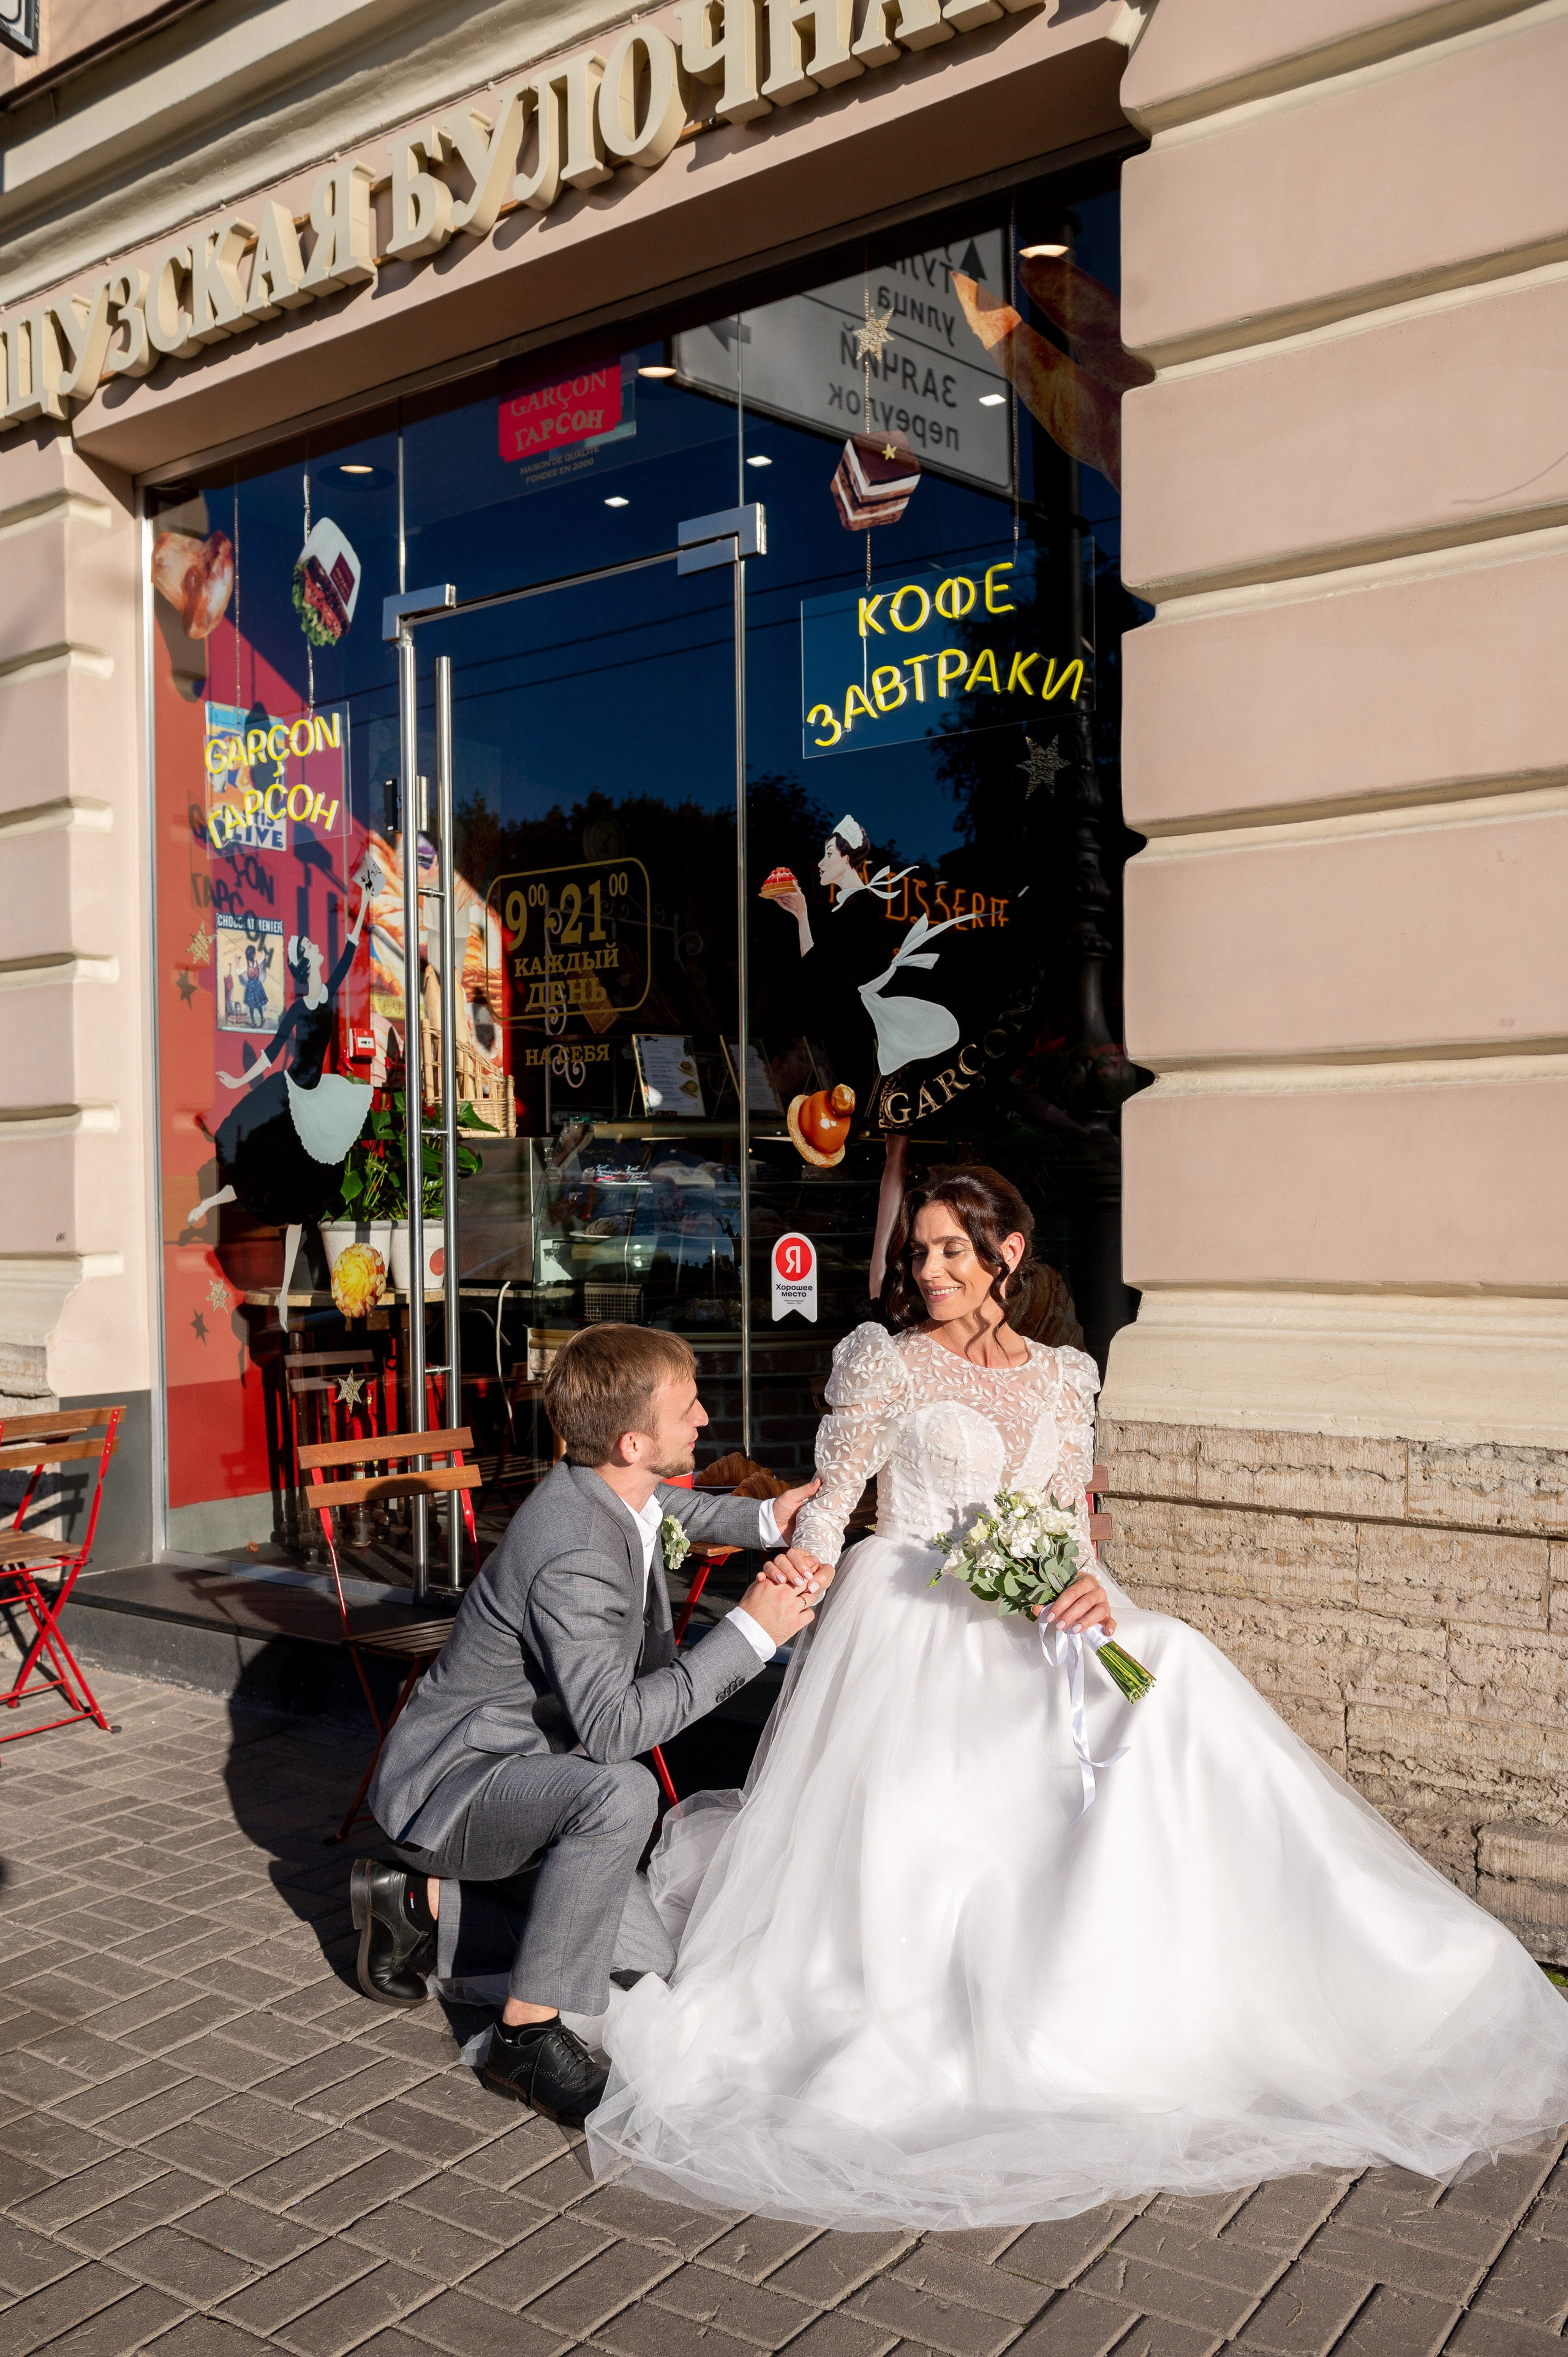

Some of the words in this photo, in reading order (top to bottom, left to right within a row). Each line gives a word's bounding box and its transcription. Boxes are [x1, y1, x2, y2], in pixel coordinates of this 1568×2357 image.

[0, 160, 375, 424] ЦУЗСКАЯ
[387, 0, 1005, 260] БУЛОЧН
[511, 369, 606, 417] GARÇON
[514, 409, 605, 452] ГАРСОН
[859, 562, 1016, 638] КОФЕ
[807, 649, 1084, 746] ЗАВТРАКИ
[205, 712, 341, 777] GARÇON
[208, 783, 339, 849] ГАРСОН
[514, 942, 619, 977] КАЖДЫЙ
[525, 977, 607, 1013] ДЕНЬ
[526, 1049, 551, 1066] НА
[558, 1044, 610, 1065] СЕБЯ
[785, 1246, 801, 1273] Я
